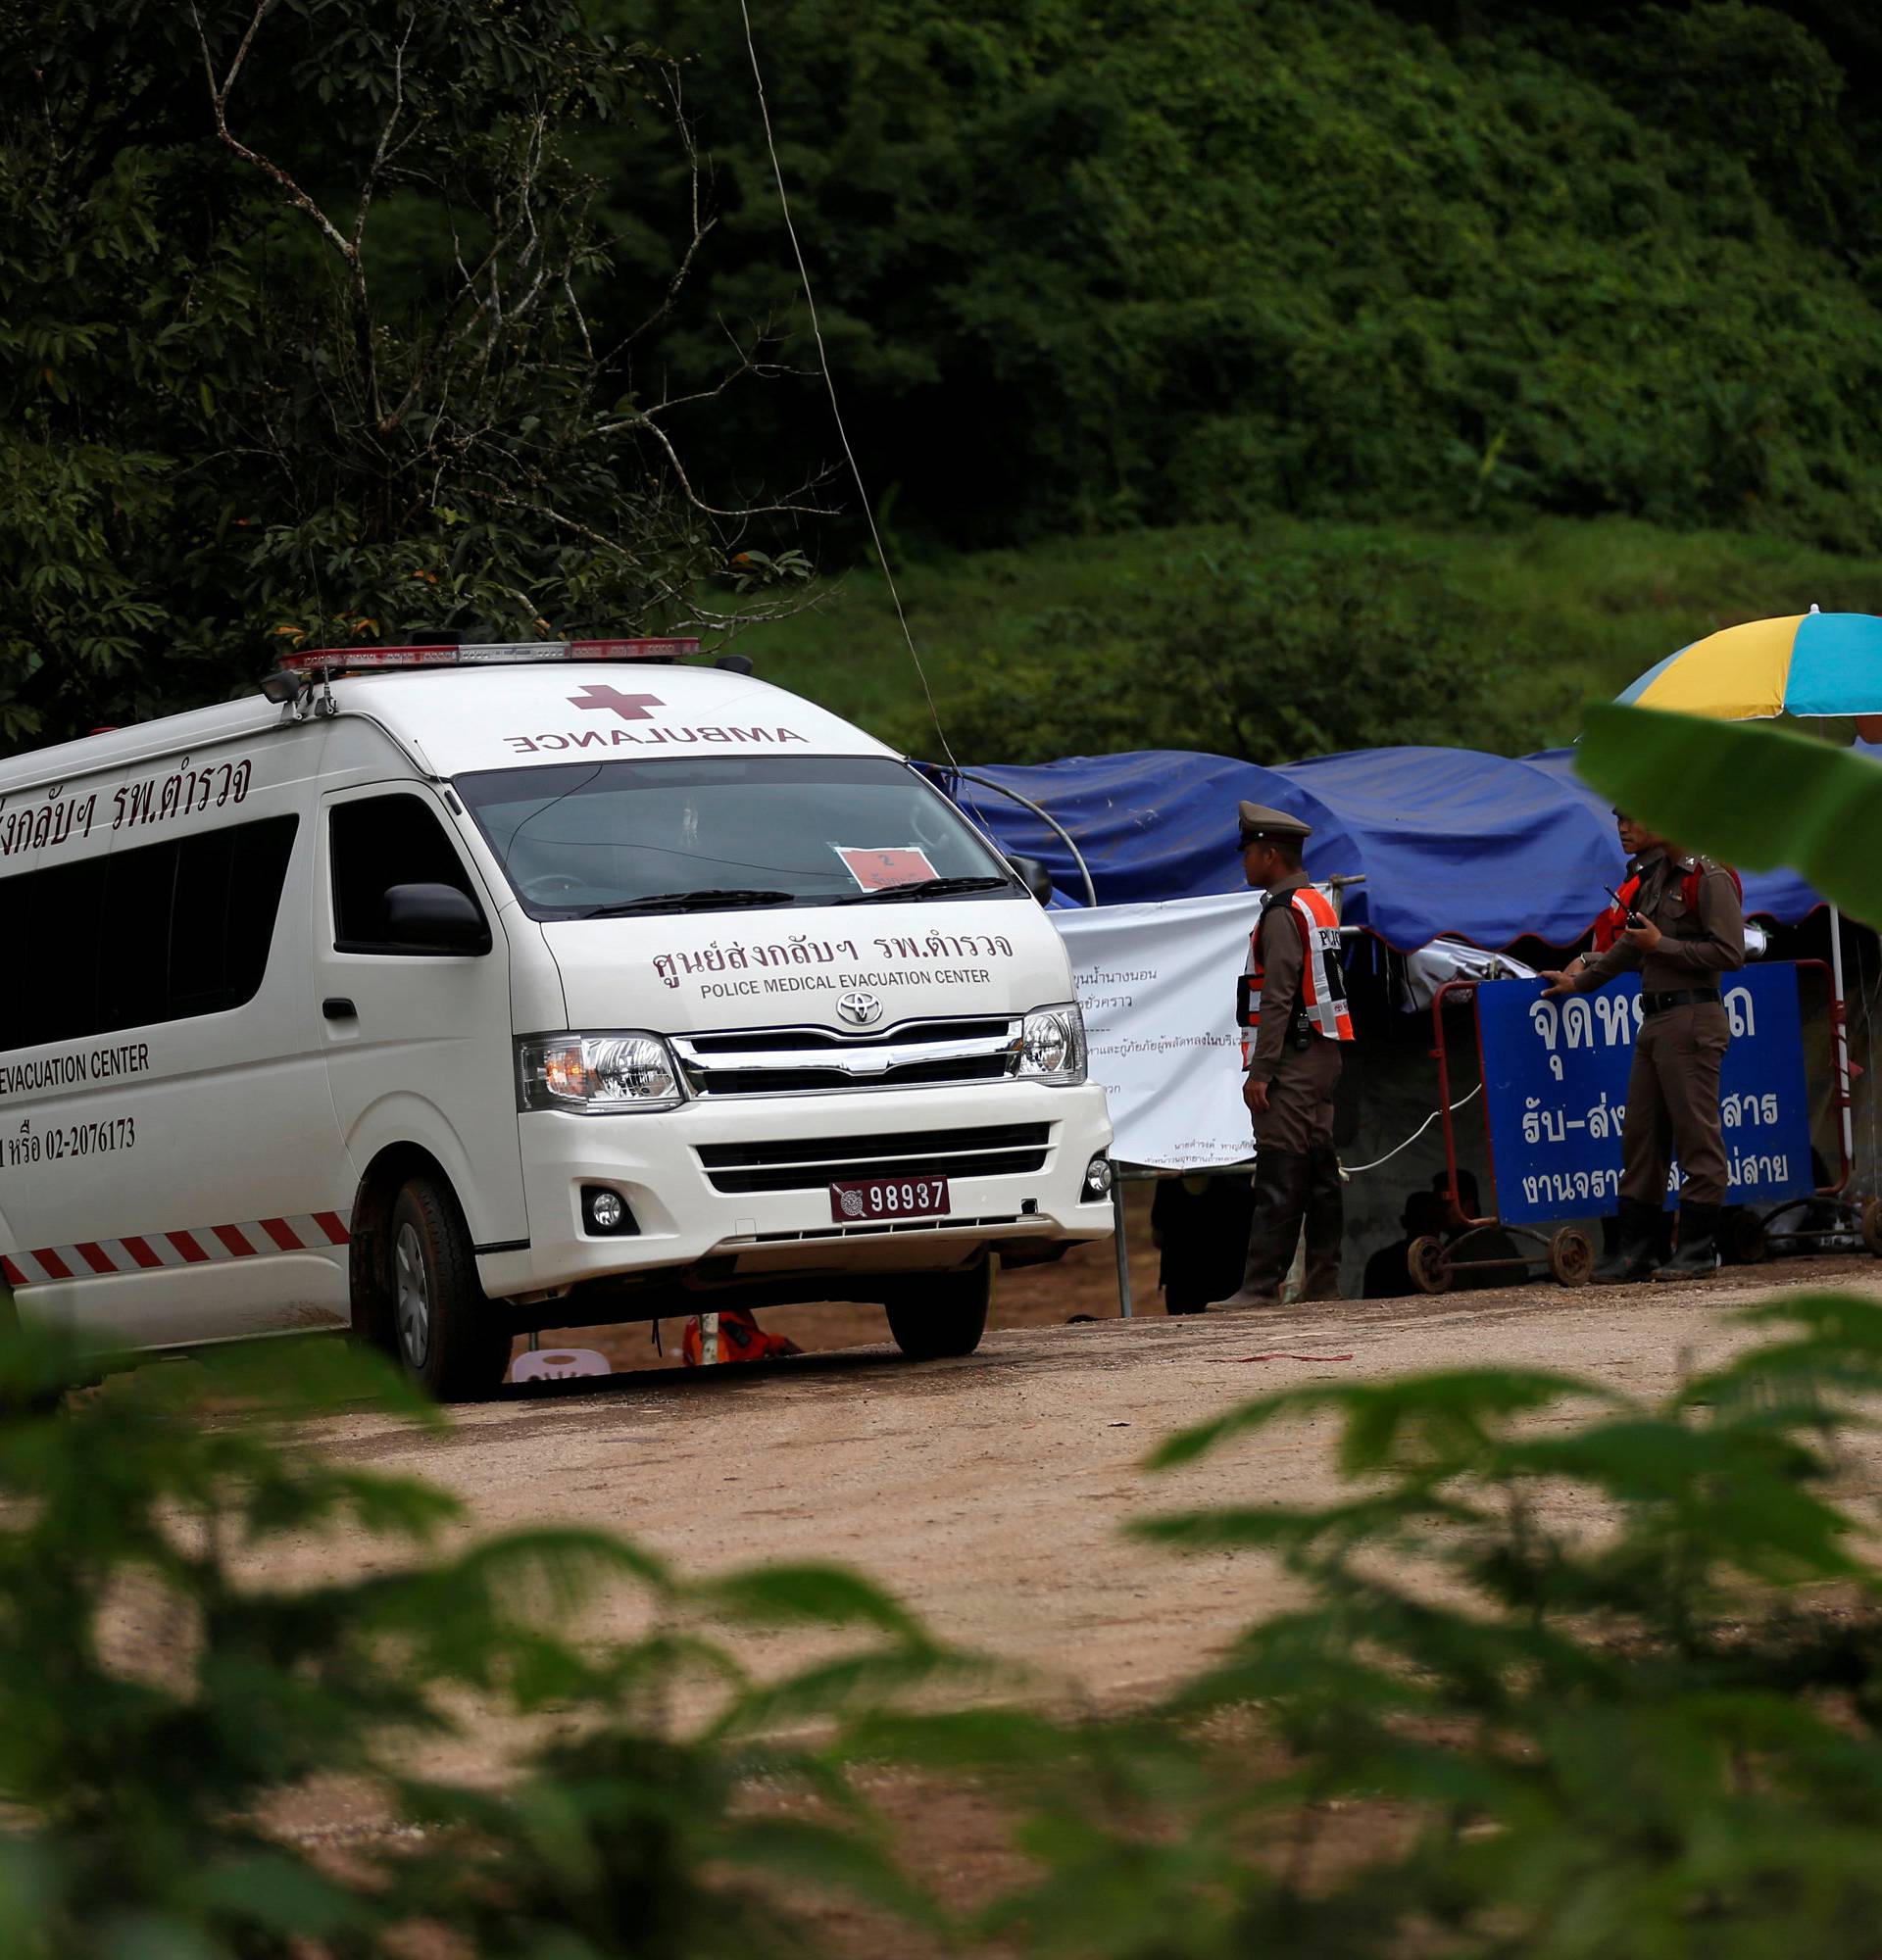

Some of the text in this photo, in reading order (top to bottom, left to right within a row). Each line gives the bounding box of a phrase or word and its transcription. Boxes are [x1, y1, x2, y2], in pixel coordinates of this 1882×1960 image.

[113, 757, 252, 830] รพ.ตำรวจ
[653, 929, 1014, 989] ศูนย์ส่งกลับฯ รพ.ตำรวจ
[700, 969, 990, 999] POLICE MEDICAL EVACUATION CENTER
[0, 1043, 149, 1095] EVACUATION CENTER
[9, 1119, 40, 1166] หรือ
[46, 1117, 135, 1160] 02-2076173
[869, 1181, 943, 1212] 98937
